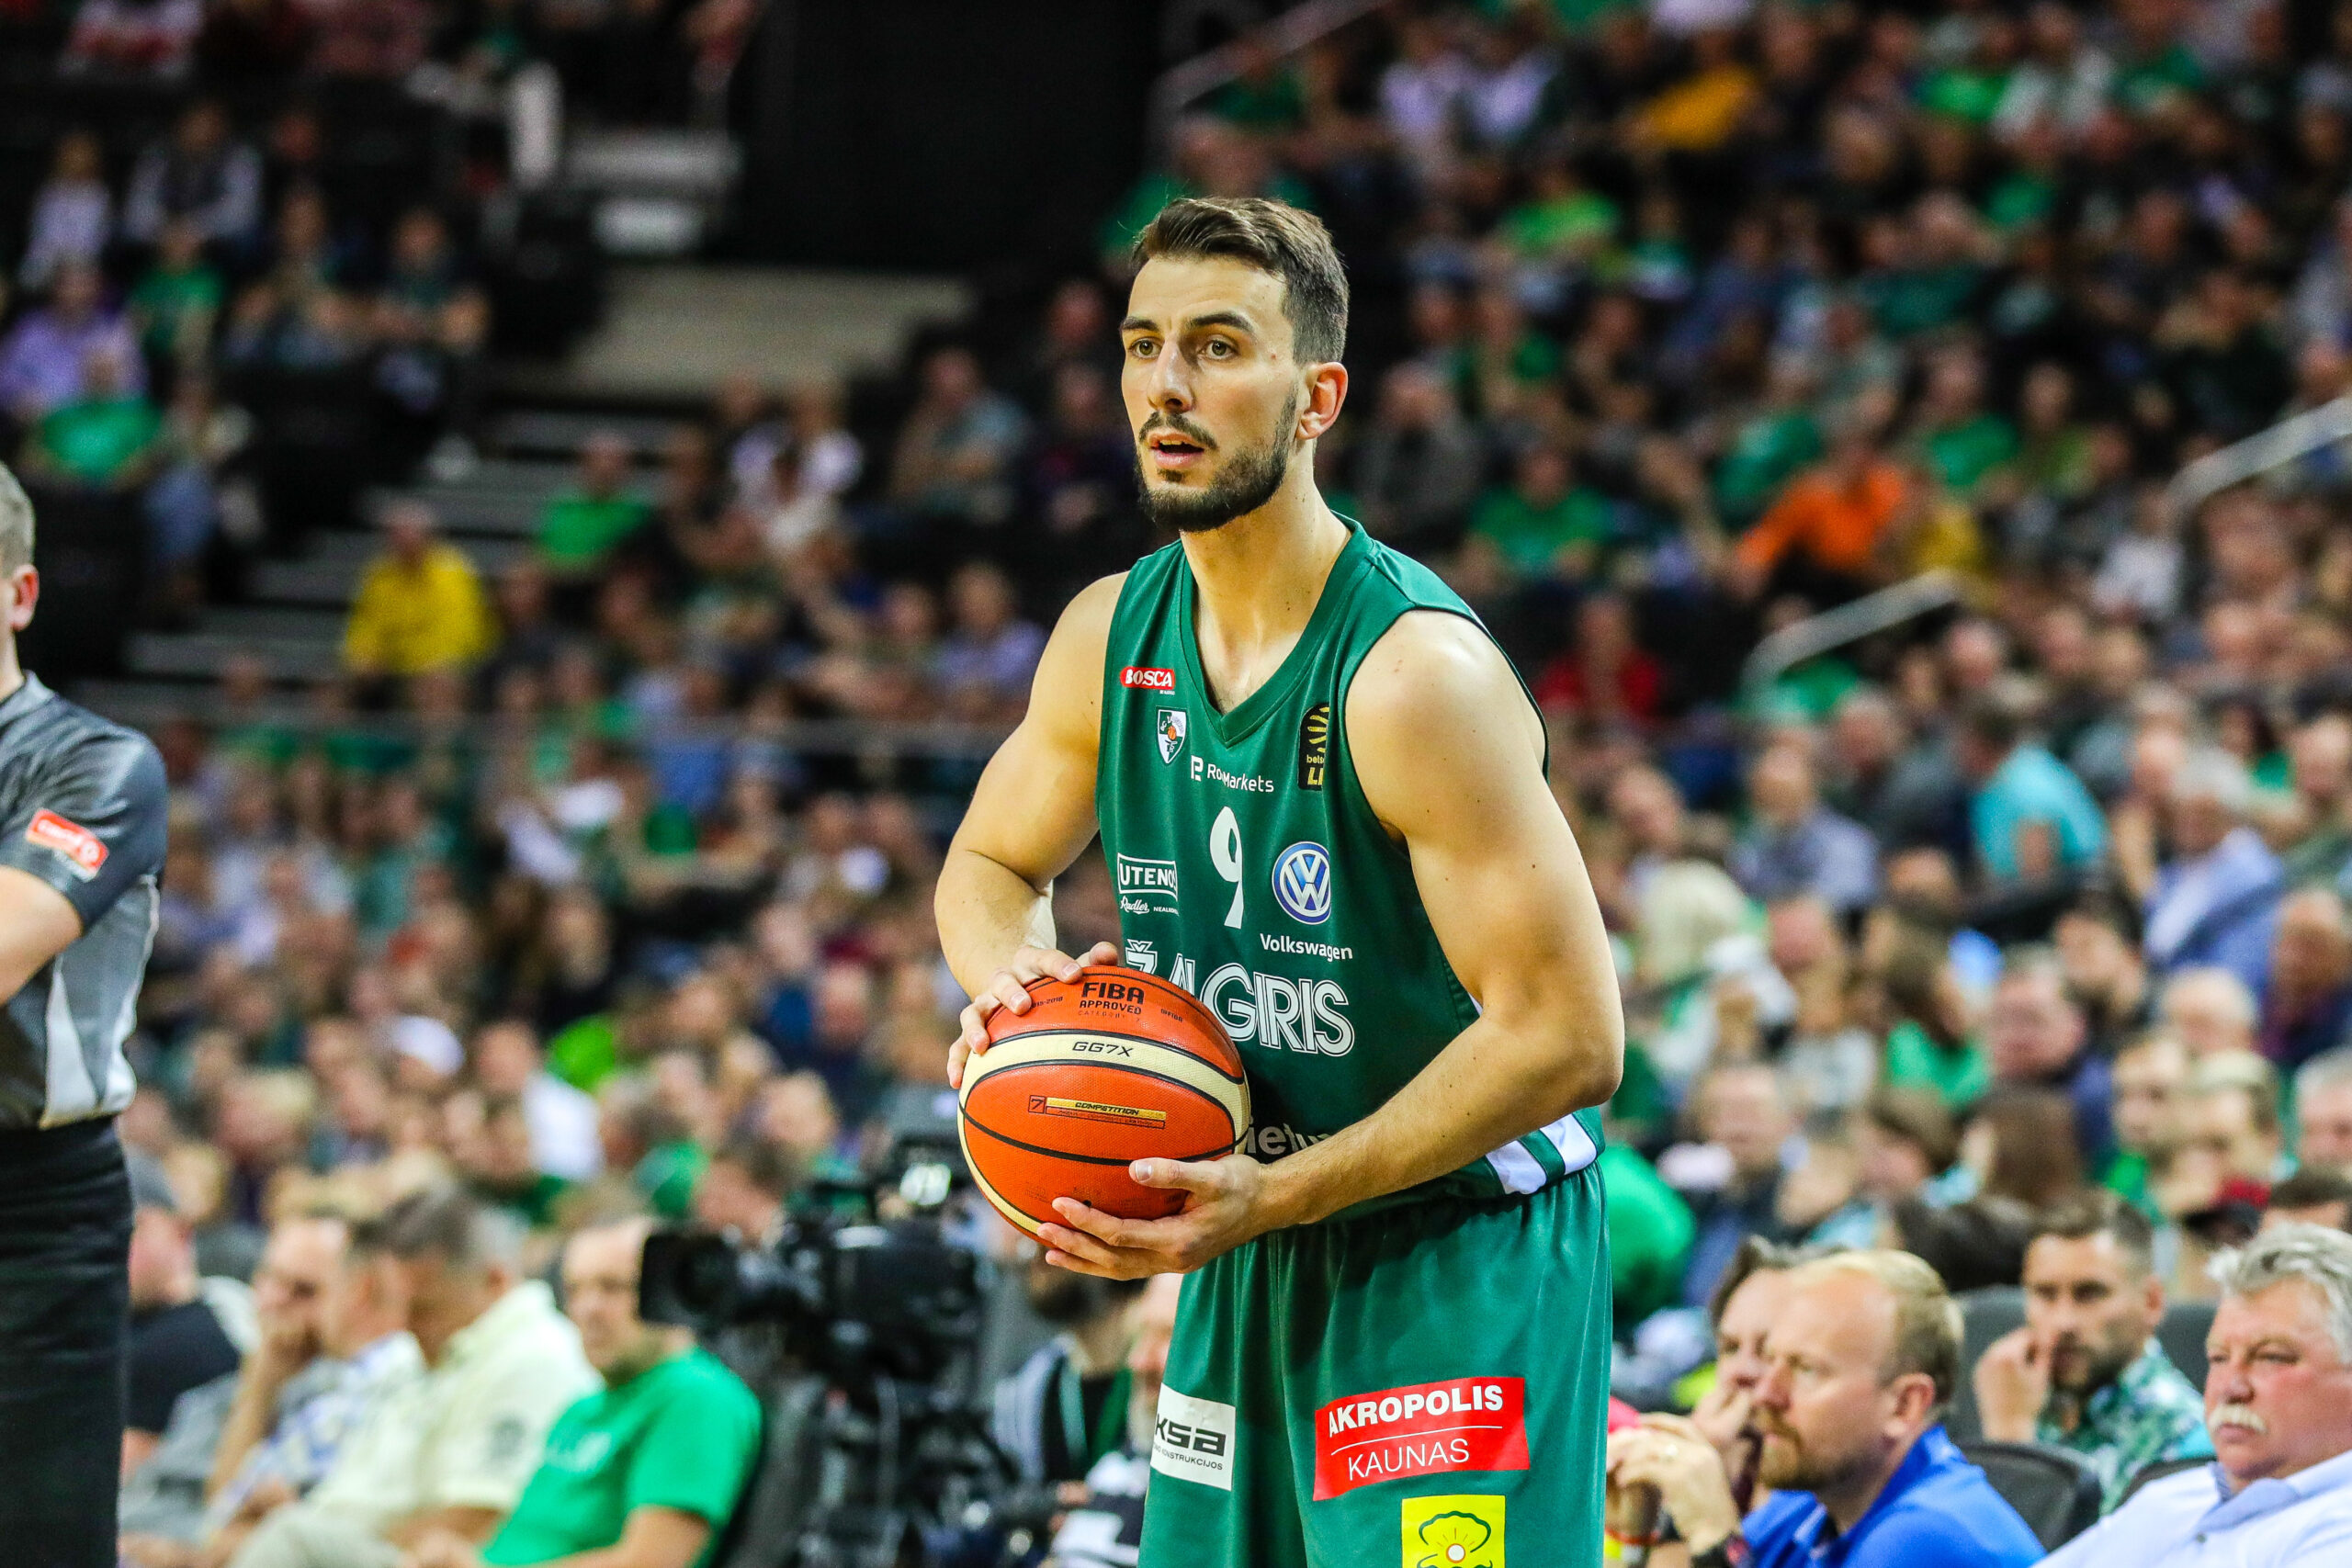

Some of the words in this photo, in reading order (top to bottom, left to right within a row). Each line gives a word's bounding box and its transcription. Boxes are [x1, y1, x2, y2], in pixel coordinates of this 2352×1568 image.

[1125, 669, 1172, 687] BOSCA
[1209, 806, 1244, 930] 9
[1120, 896, 1149, 915] Radler
[1260, 933, 1353, 962] Volkswagen
[1081, 982, 1145, 1005] FIBA
[1079, 999, 1142, 1015] APPROVED
[1072, 1041, 1134, 1057] GG7X
[1031, 1099, 1044, 1111] 7
[1075, 1101, 1139, 1116] COMPETITION
[1329, 1384, 1504, 1438] AKROPOLIS
[1348, 1438, 1470, 1482] KAUNAS
